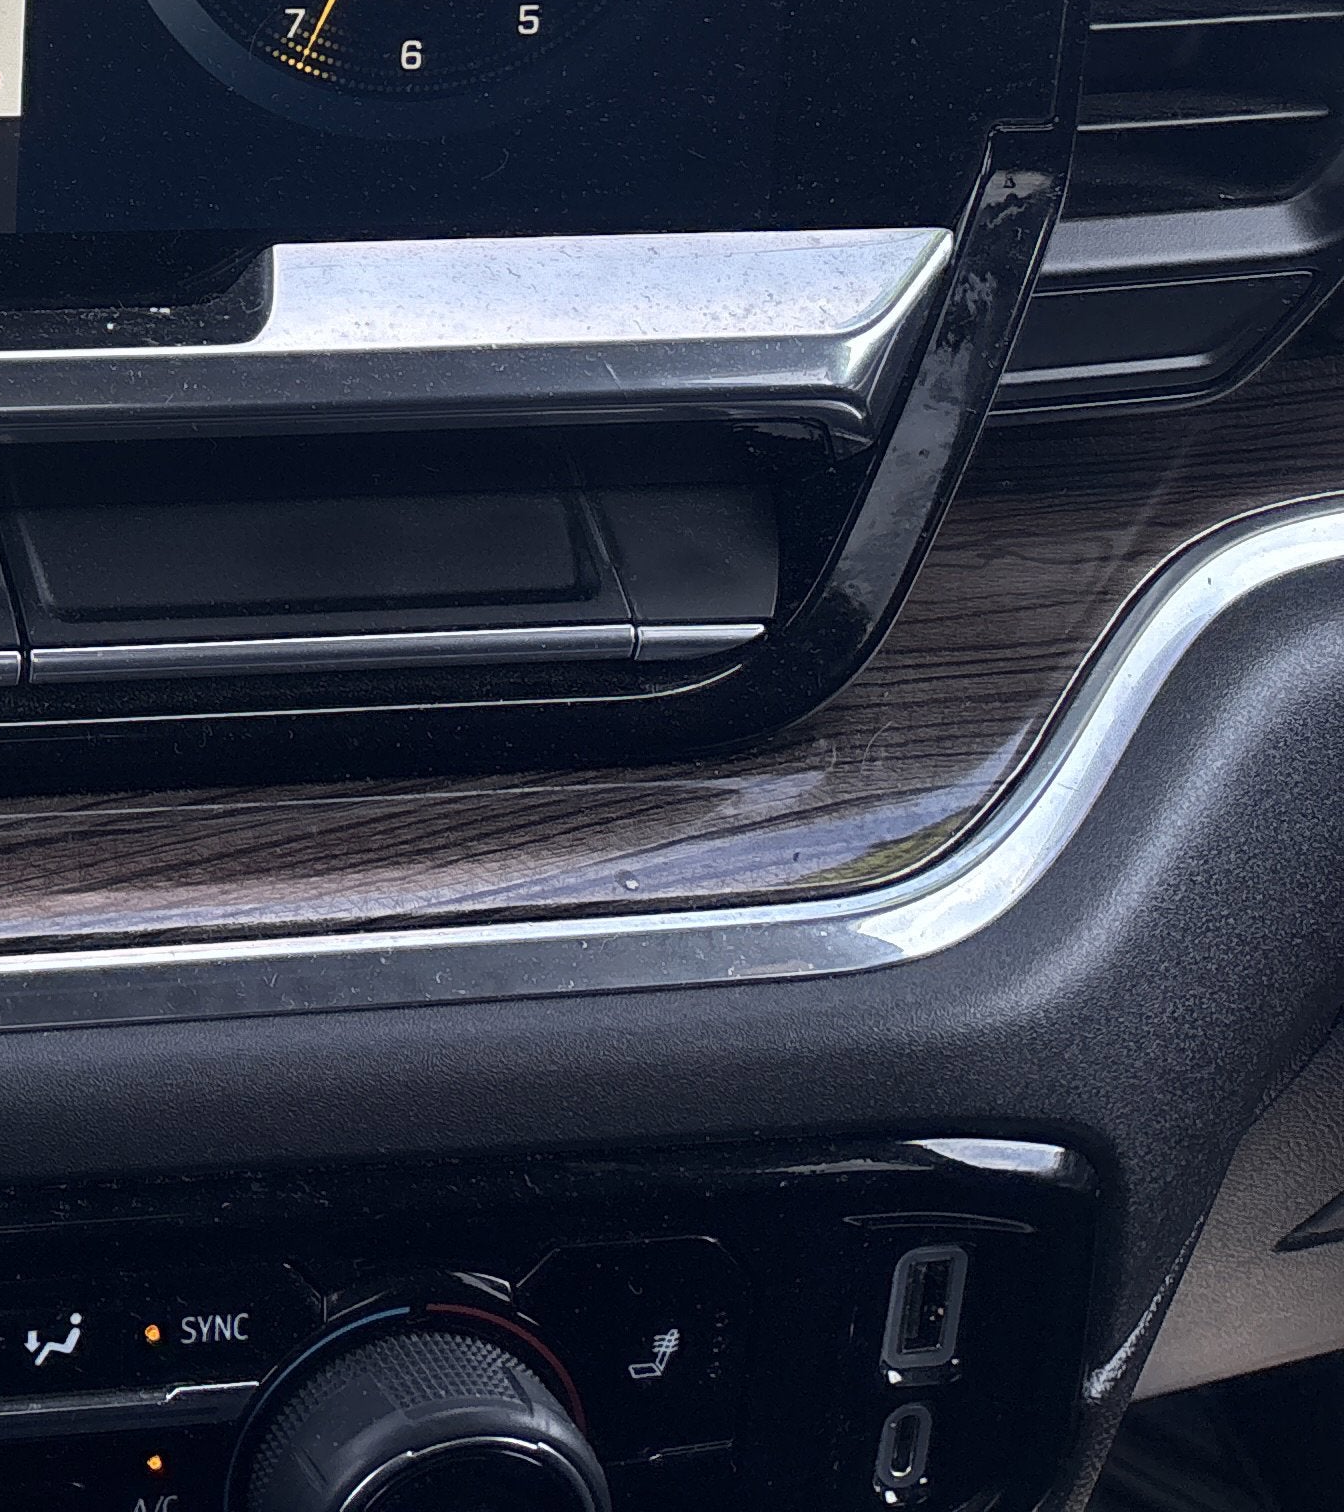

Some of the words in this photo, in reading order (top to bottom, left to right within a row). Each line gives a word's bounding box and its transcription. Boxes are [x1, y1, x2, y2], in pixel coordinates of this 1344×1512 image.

[284, 8, 306, 39] 7
[517, 4, 540, 35] 5
[400, 40, 423, 70] 6
[181, 1312, 249, 1344] SYNC
